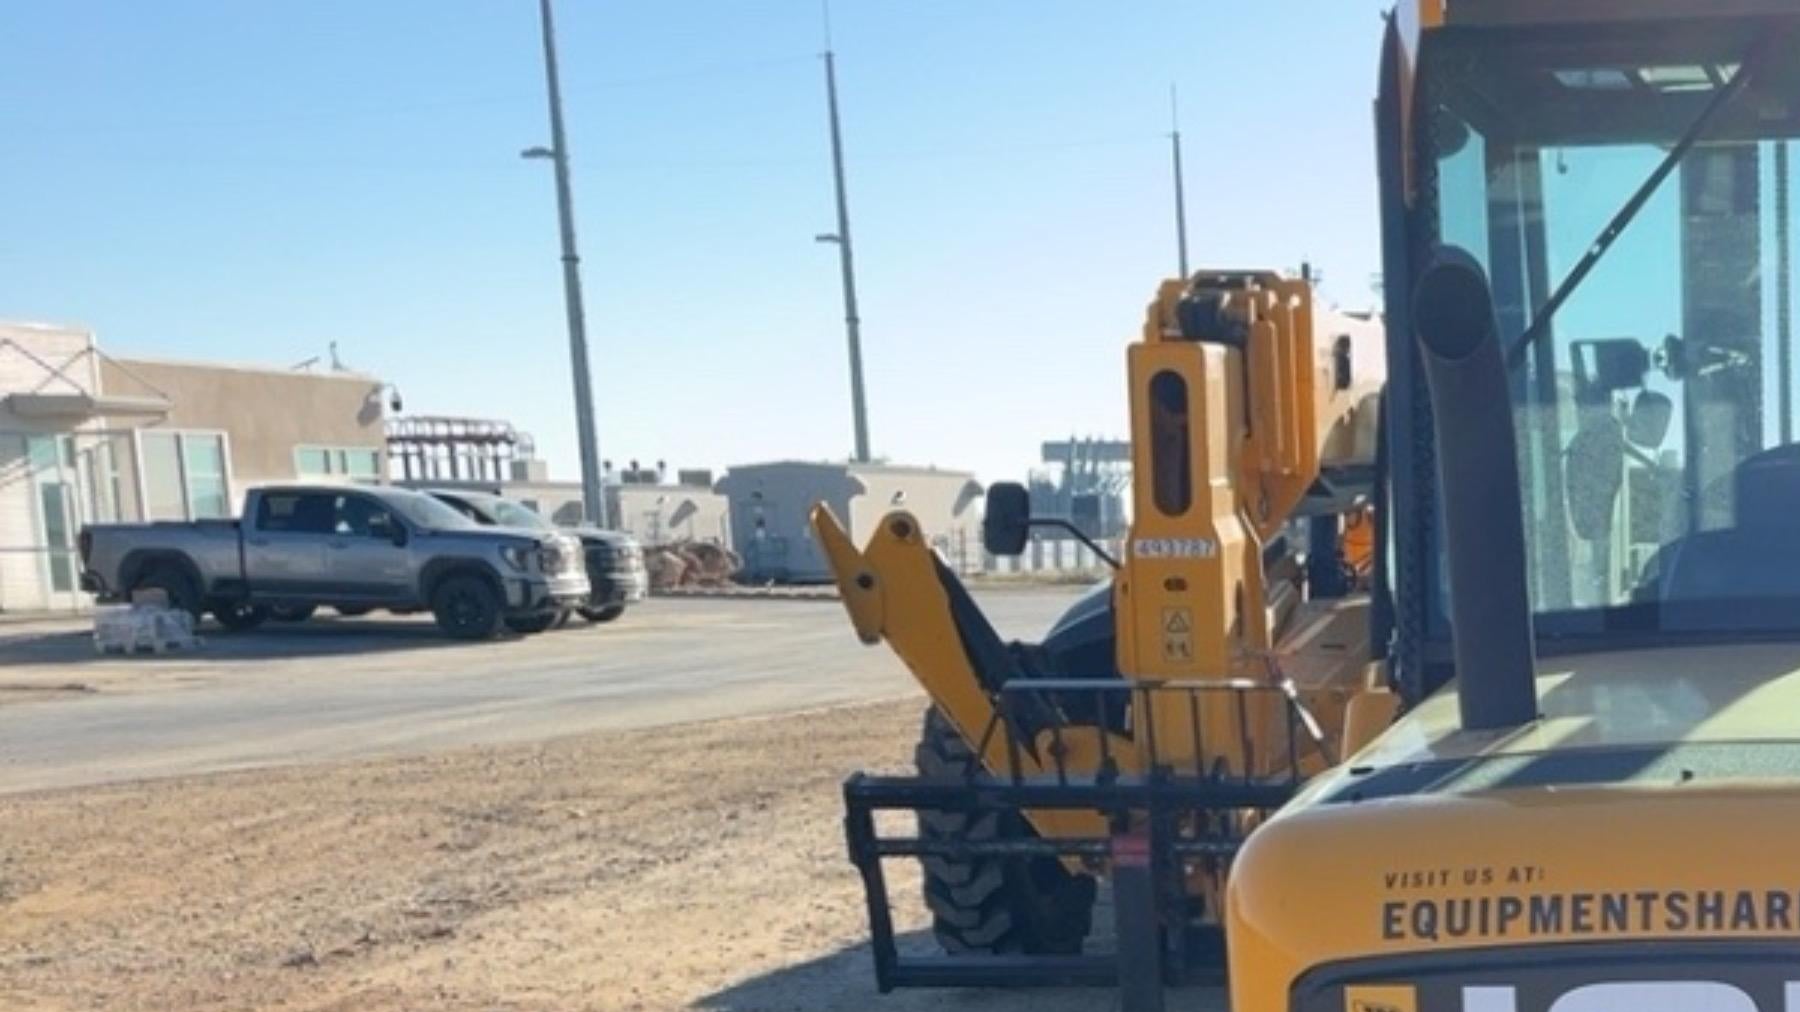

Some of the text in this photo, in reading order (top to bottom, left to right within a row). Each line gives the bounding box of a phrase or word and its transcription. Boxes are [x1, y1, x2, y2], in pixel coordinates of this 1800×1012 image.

[1385, 865, 1546, 889] VISIT US AT:
